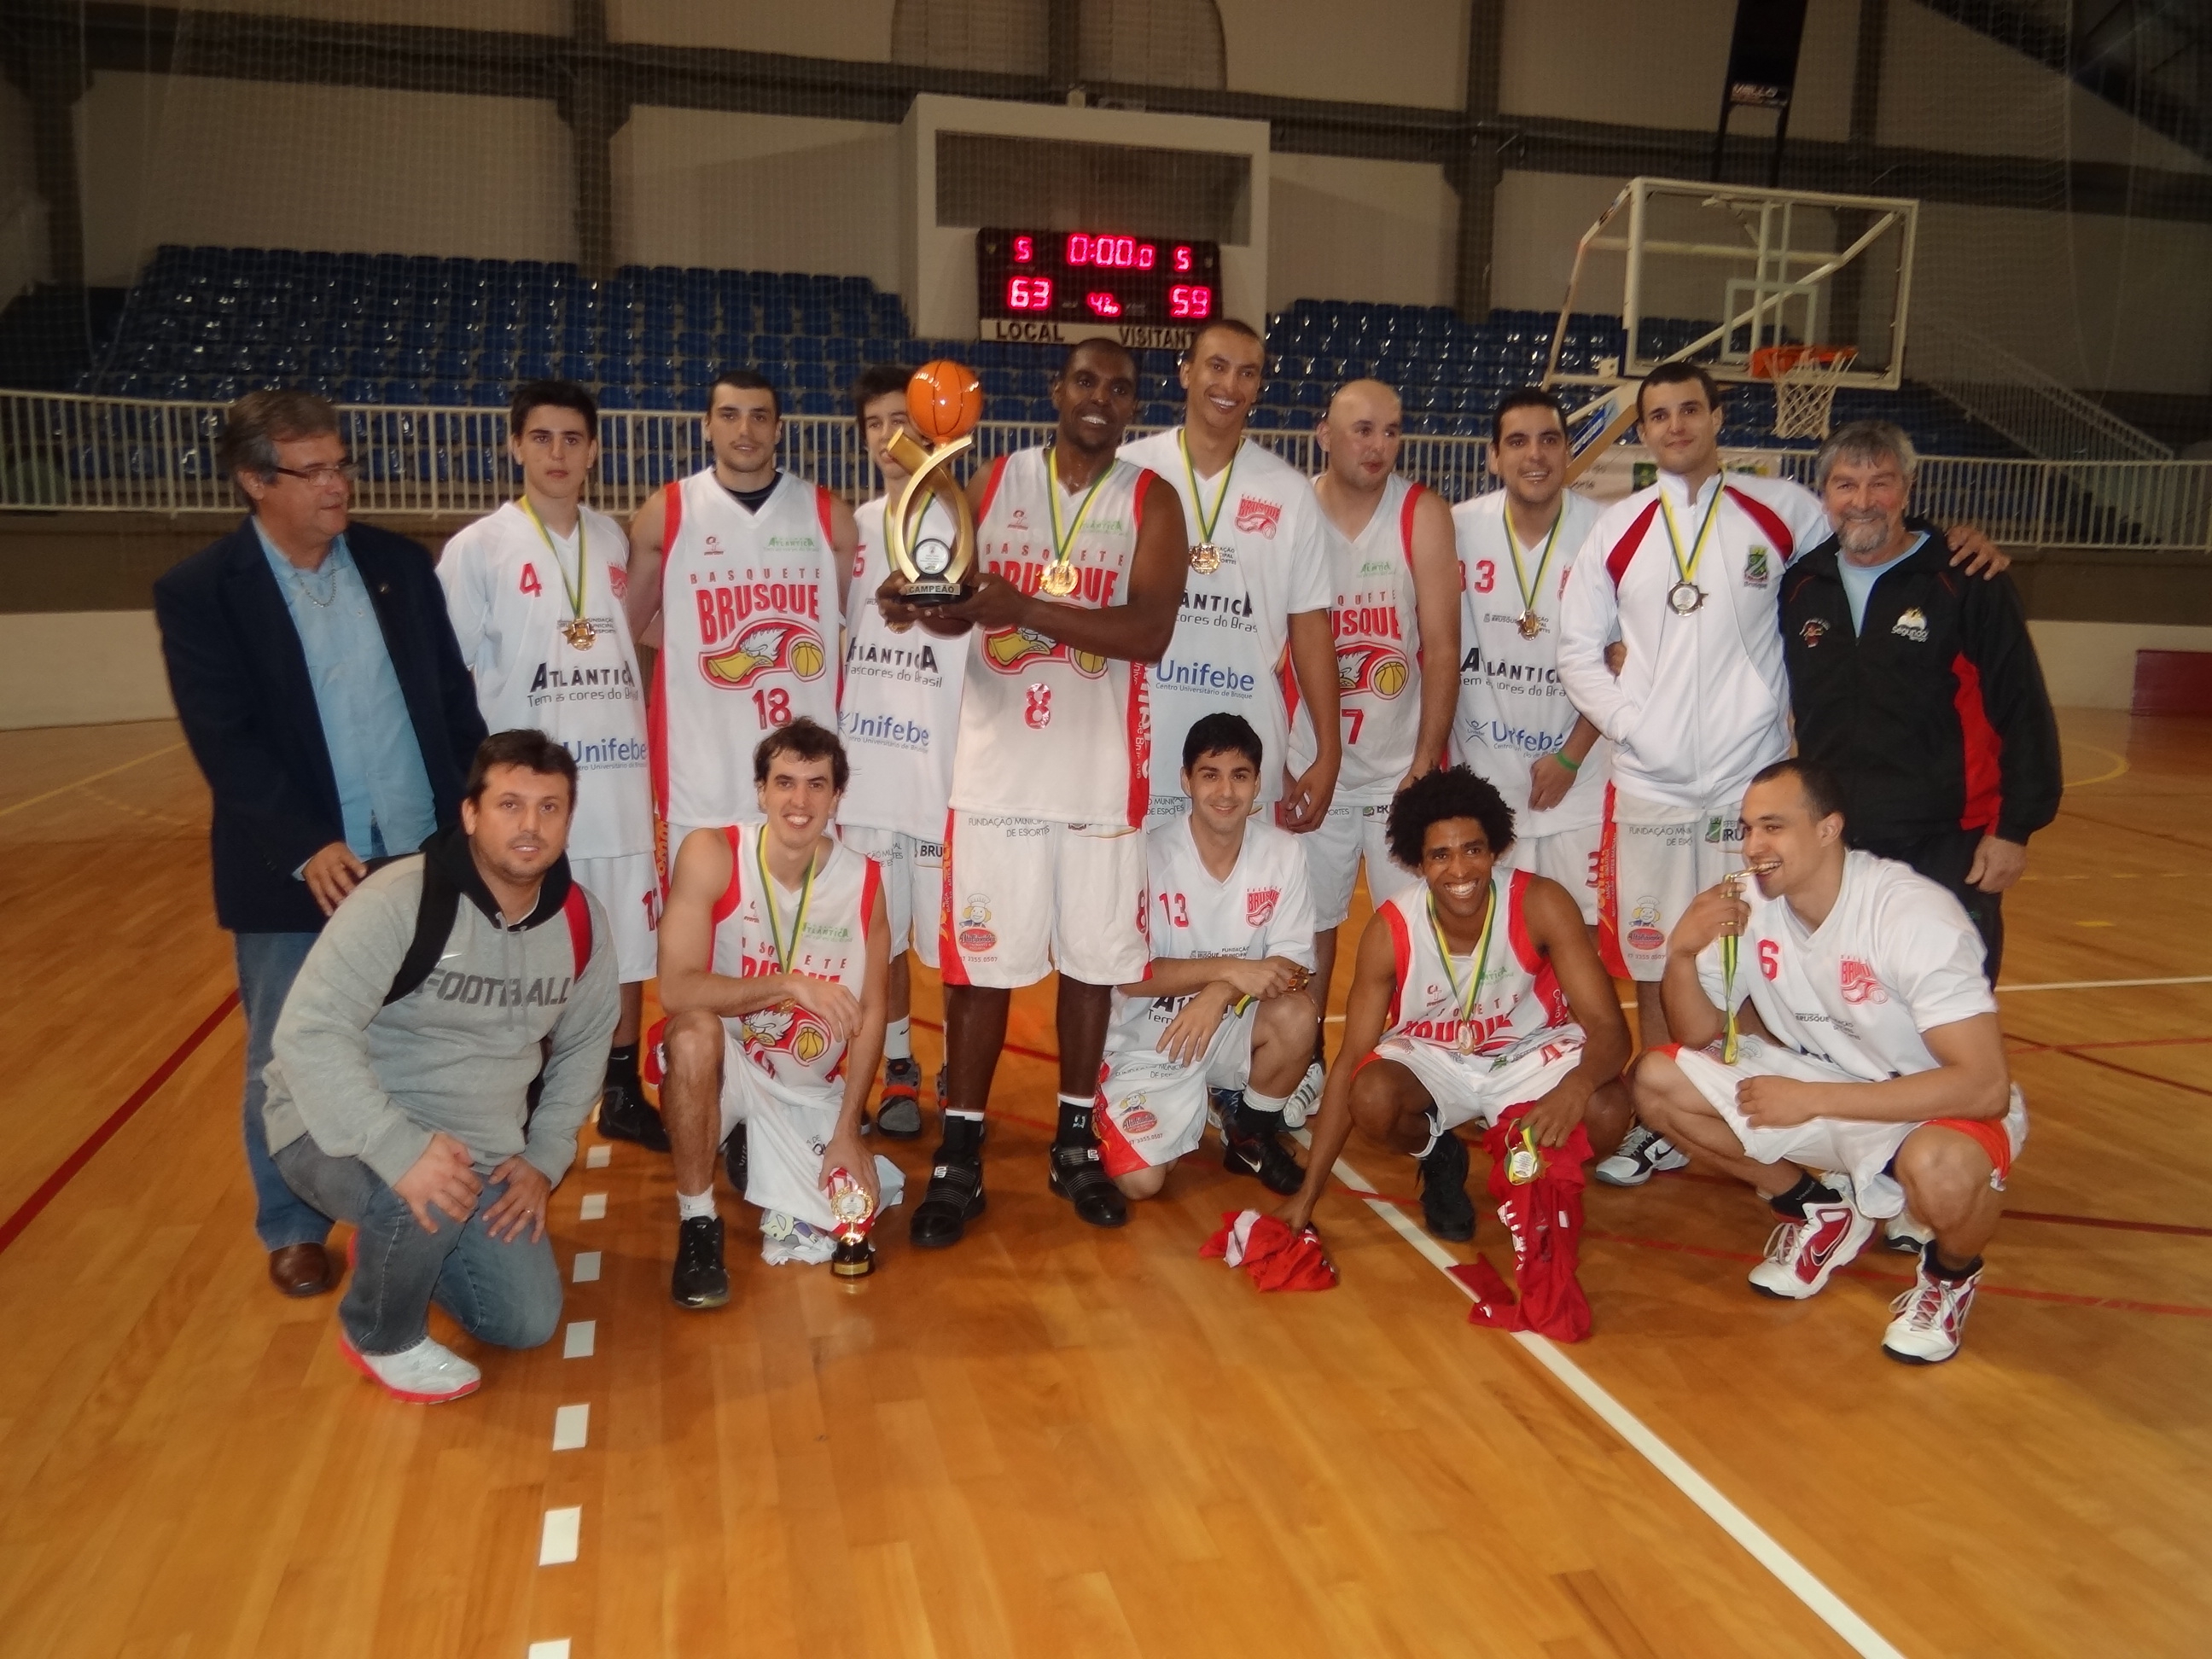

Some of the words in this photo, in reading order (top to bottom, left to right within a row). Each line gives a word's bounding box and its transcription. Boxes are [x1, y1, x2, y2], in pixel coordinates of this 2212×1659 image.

[1010, 278, 1051, 309] 63
[1172, 287, 1210, 317] 59
[996, 322, 1065, 341] LOCAL
[1119, 327, 1196, 350] VISITANT
[985, 543, 1124, 567] BASQETE
[520, 562, 543, 597] 4
[690, 567, 821, 585] BASQUETE
[909, 585, 954, 594] CAMPEÃO
[1337, 590, 1396, 607] QUETE
[696, 584, 819, 645] BRUSQUE
[1181, 591, 1253, 617] ÂNTICA
[1214, 614, 1228, 628] do
[1231, 616, 1258, 633] Bras
[1329, 606, 1402, 642] USQUE
[530, 662, 636, 693] ATLÂNTICA
[897, 669, 911, 682] do
[915, 670, 942, 688] Brasil
[1155, 660, 1254, 692] Unifebe
[1464, 678, 1481, 686] em
[1528, 684, 1542, 696] do
[1545, 686, 1566, 697] Bra
[527, 693, 552, 707] Tem
[569, 690, 605, 701] cores
[607, 687, 622, 700] do
[1155, 683, 1178, 691] Centro
[1179, 684, 1220, 696] Universitário
[1231, 690, 1253, 700] Brusque
[752, 688, 793, 730] 18
[1025, 683, 1051, 730] 8
[969, 817, 1012, 828] FUNDAÇÃO
[1007, 829, 1016, 837] DE
[1629, 827, 1673, 837] FUNDAÇÃO
[1667, 838, 1676, 847] DE
[1159, 893, 1189, 928] 13
[1758, 940, 1778, 981] 6
